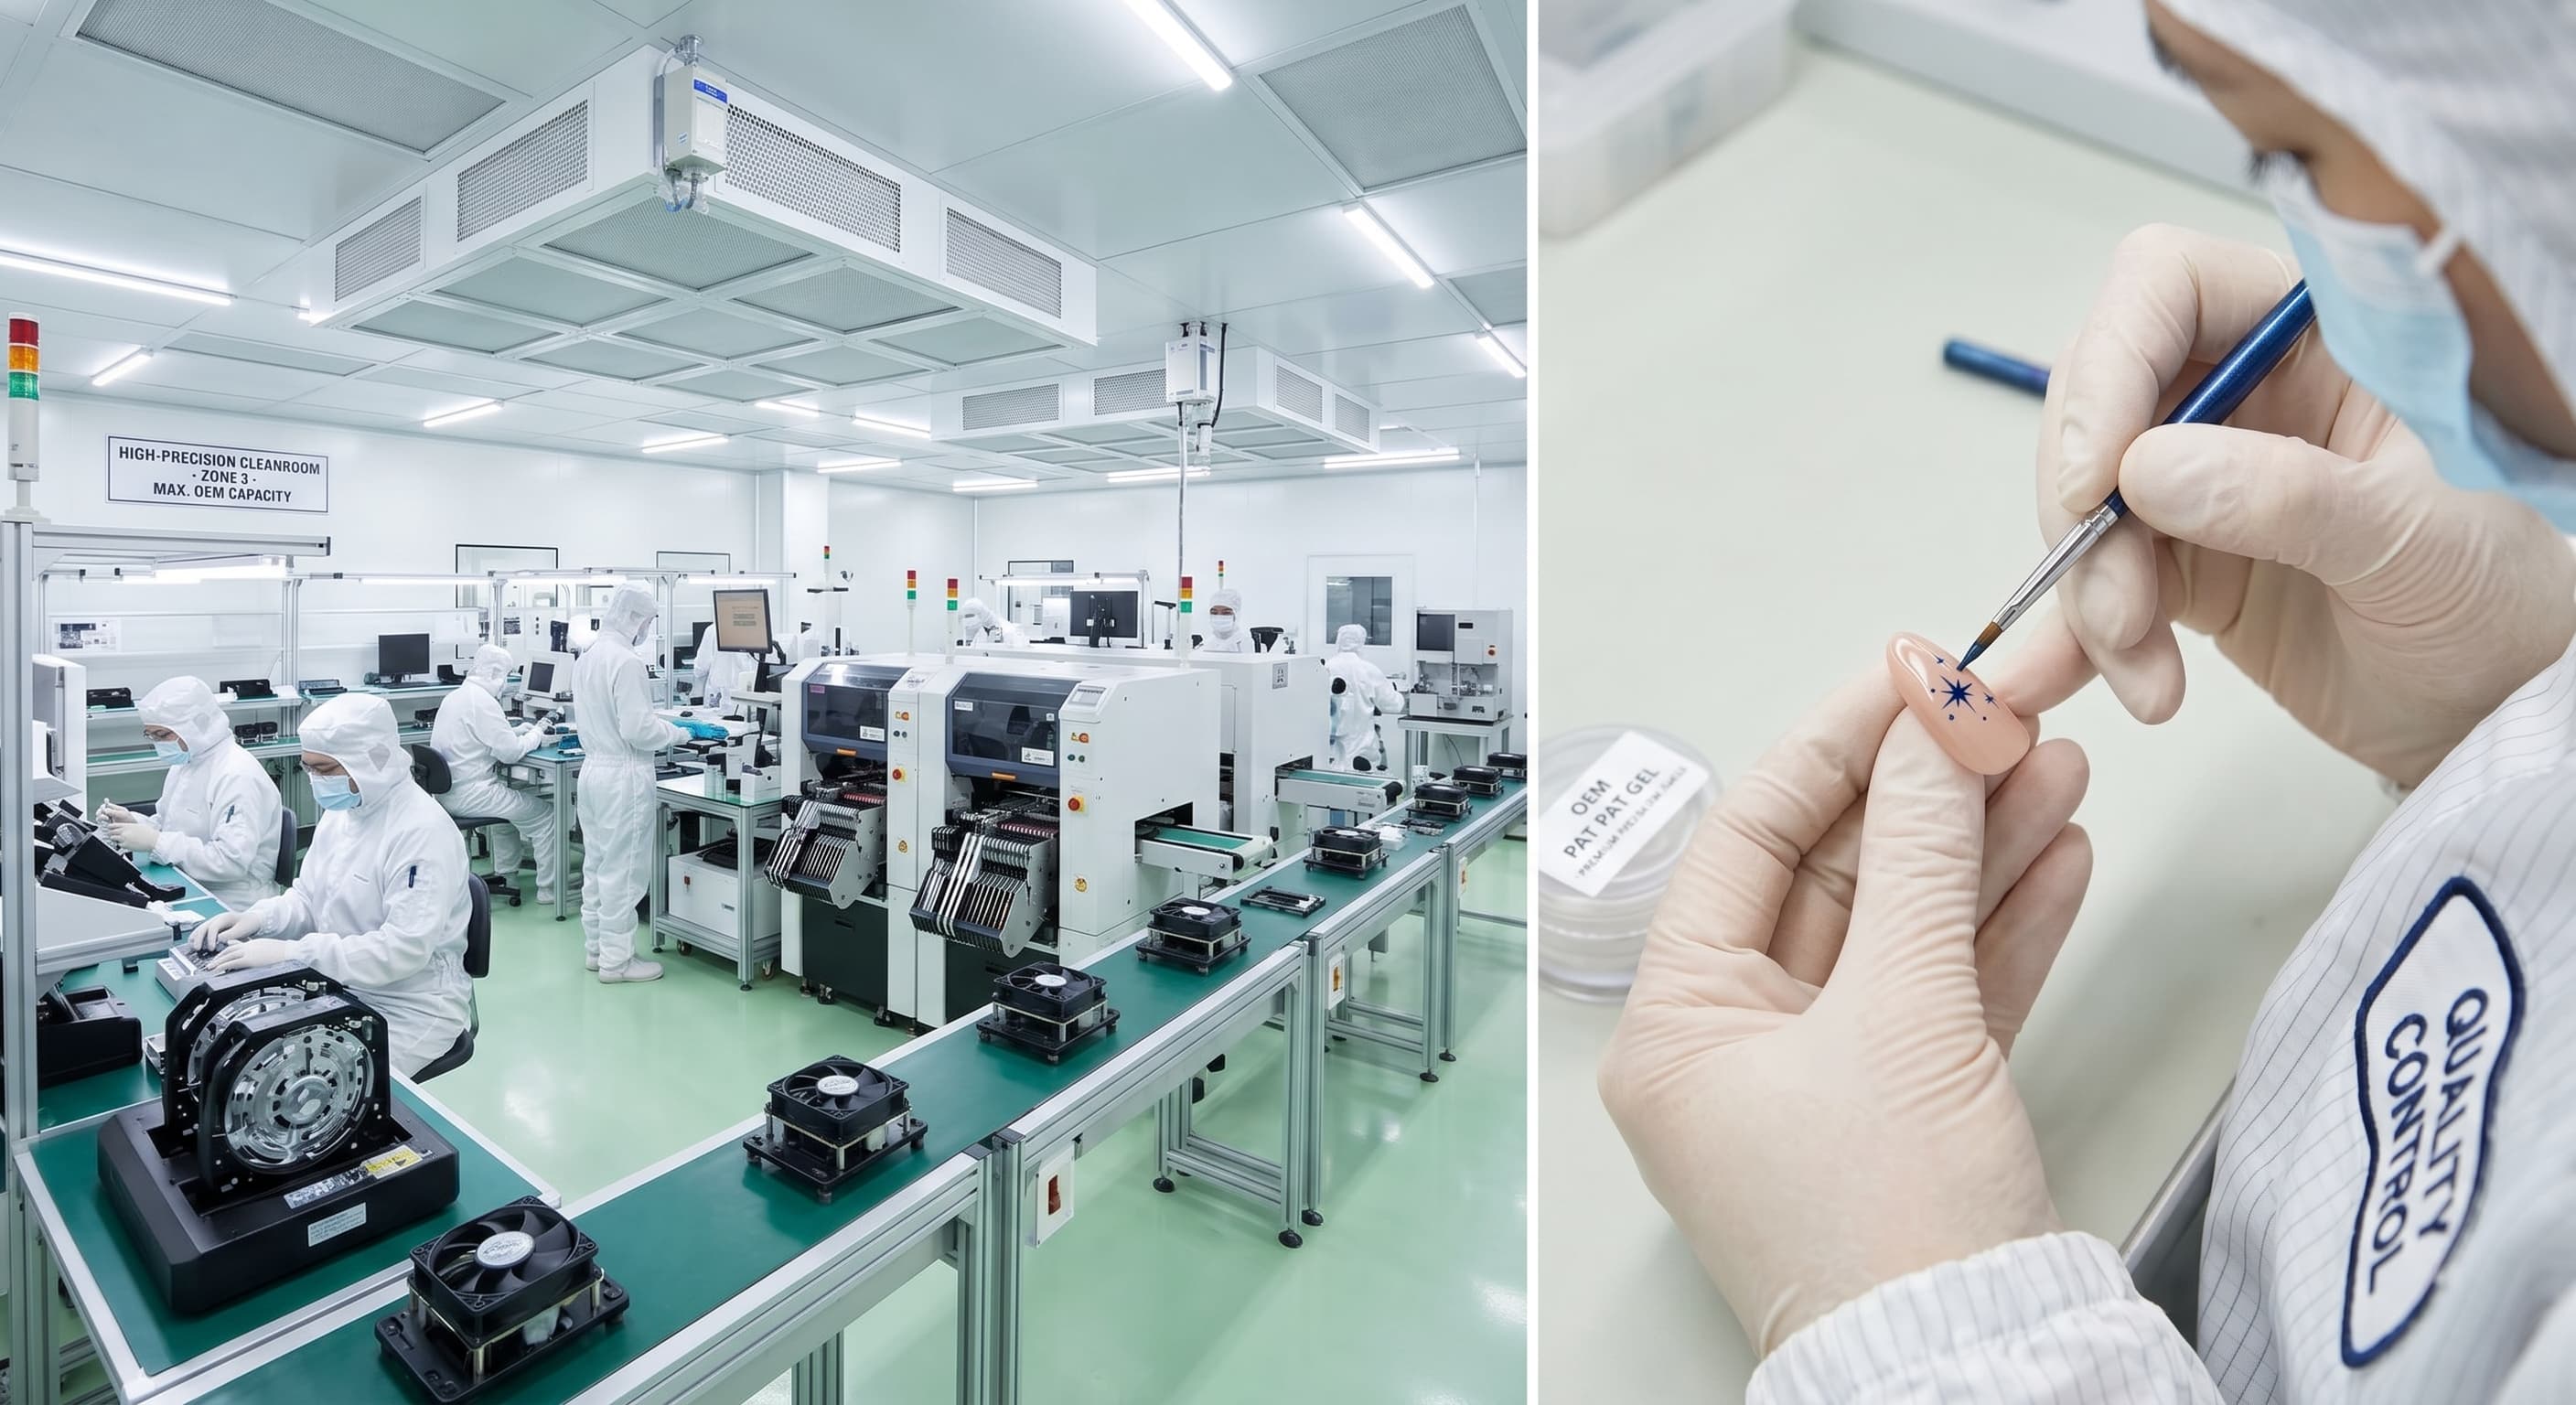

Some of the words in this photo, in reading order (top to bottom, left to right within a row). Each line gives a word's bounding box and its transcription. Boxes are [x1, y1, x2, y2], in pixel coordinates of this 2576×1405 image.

[119, 445, 236, 468] HIGH-PRECISION
[240, 456, 320, 475] CLEANROOM
[200, 469, 238, 484] ZONE
[241, 473, 249, 485] 3
[154, 482, 190, 497] MAX.
[194, 485, 225, 499] OEM
[229, 488, 292, 502] CAPACITY
[1562, 825, 1598, 858] PAT
[1594, 794, 1628, 827] PAT
[1626, 767, 1660, 795] GEL
[1571, 779, 1612, 816] OEM
[2418, 987, 2489, 1238] QUALITY
[2367, 1013, 2430, 1295] CONTROL
